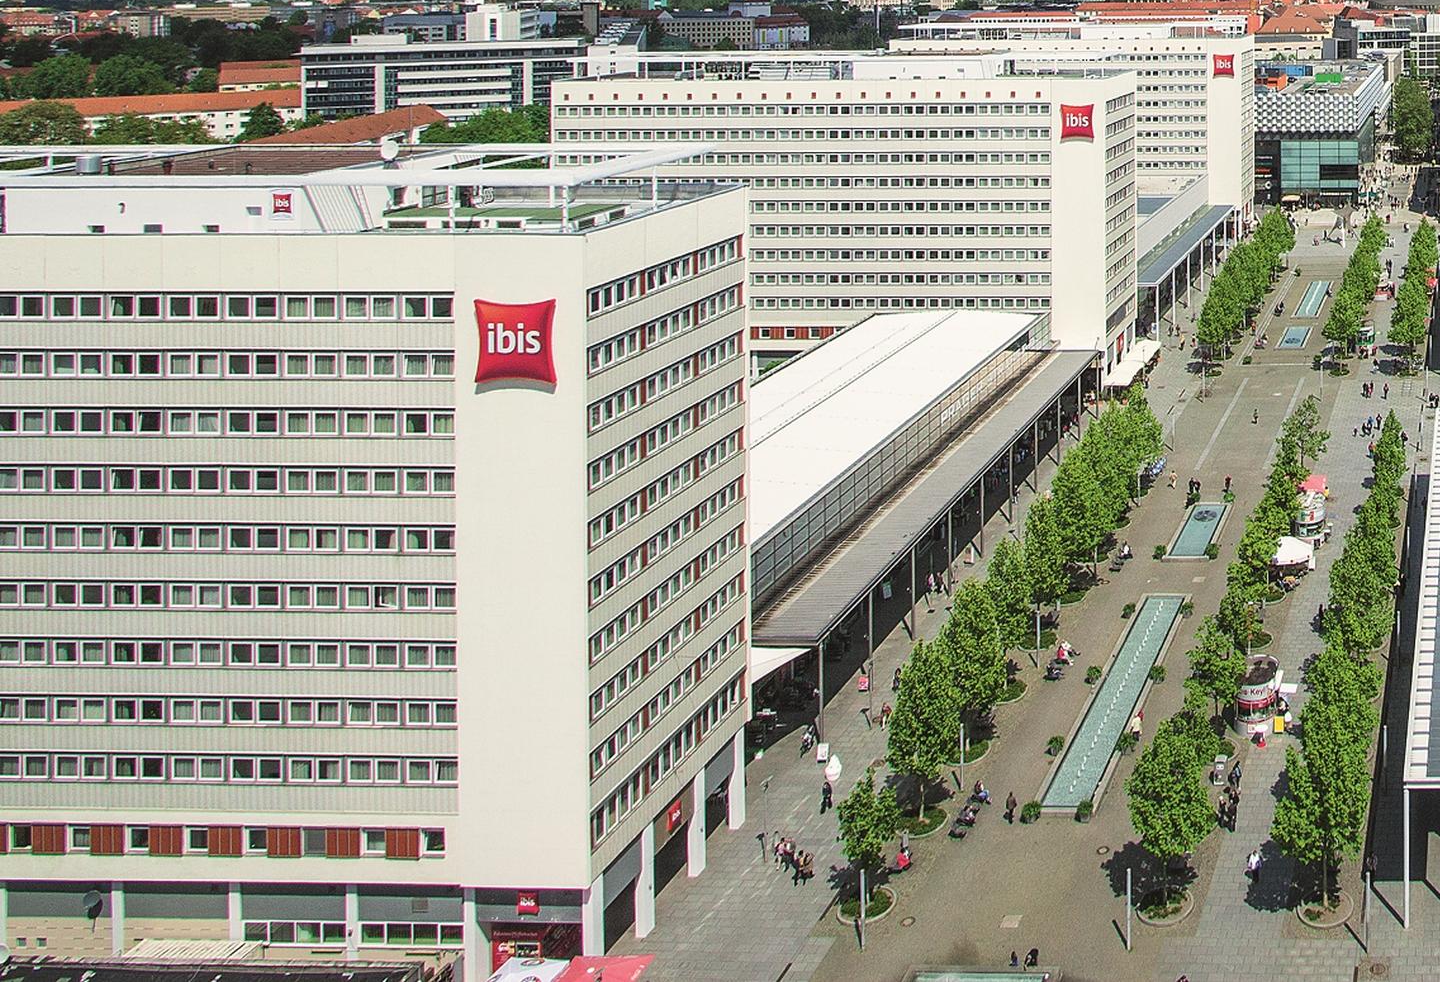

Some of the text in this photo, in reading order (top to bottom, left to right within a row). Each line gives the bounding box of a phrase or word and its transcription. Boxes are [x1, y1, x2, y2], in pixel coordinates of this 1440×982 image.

[1216, 59, 1231, 68] ibis
[1066, 113, 1089, 127] ibis
[275, 198, 290, 208] ibis
[487, 322, 541, 354] ibis
[519, 897, 535, 906] ibis
